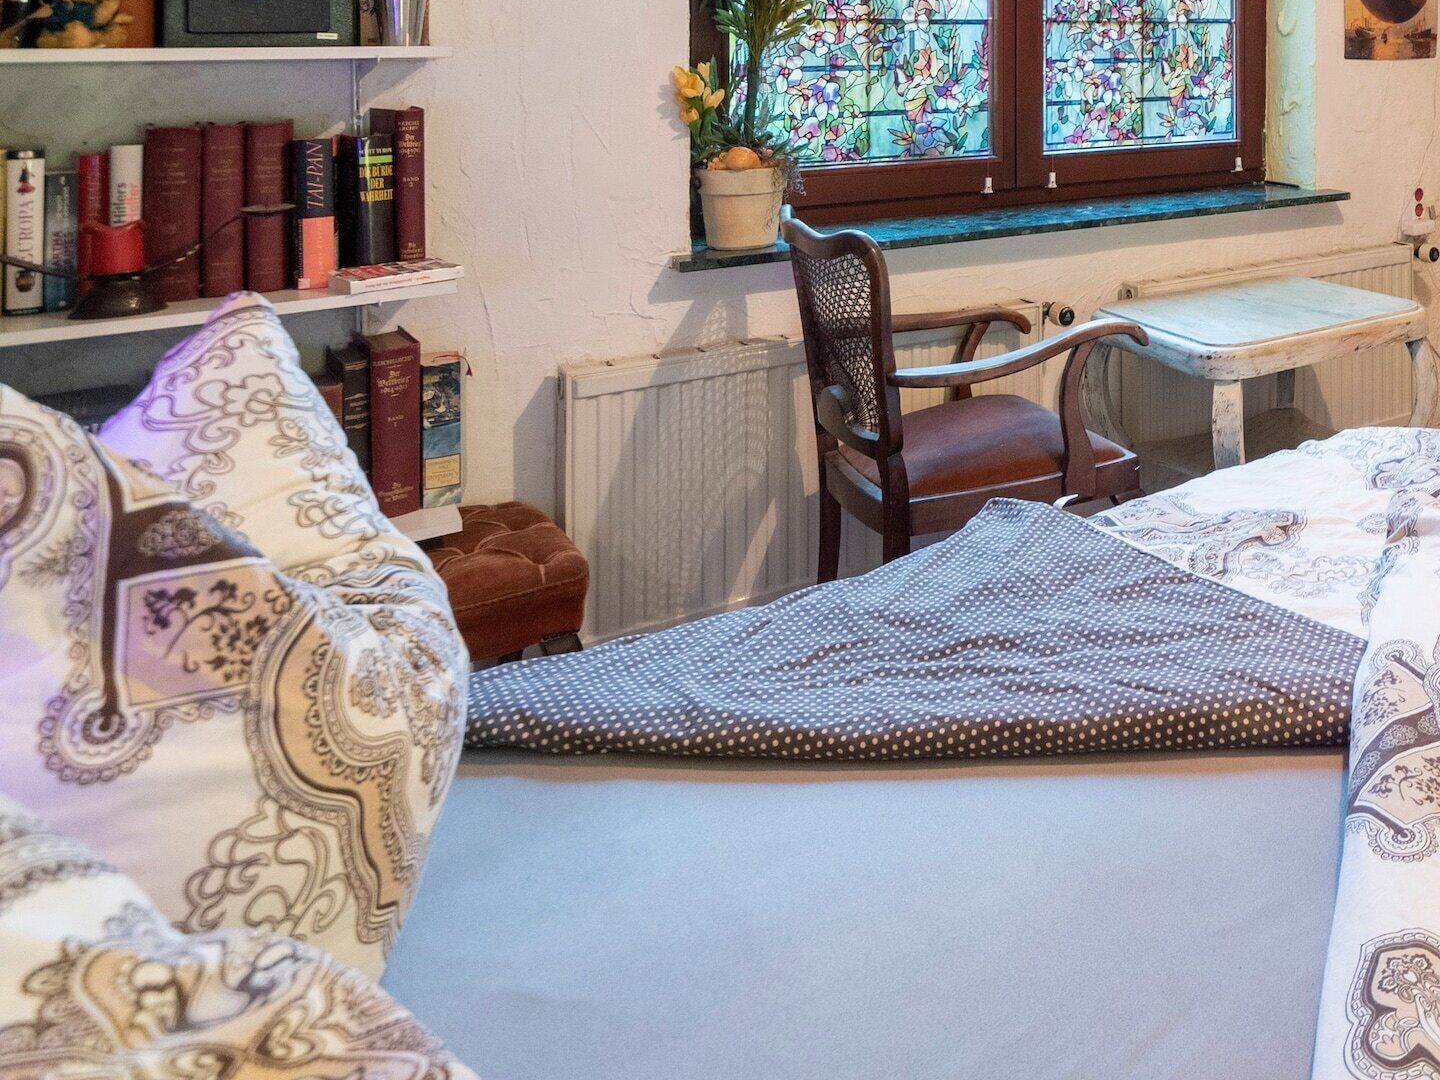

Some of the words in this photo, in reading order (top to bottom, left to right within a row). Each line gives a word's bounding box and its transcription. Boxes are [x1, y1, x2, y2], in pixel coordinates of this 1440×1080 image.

[113, 182, 127, 224] Hitlers
[306, 141, 324, 209] TAI-PAN
[19, 199, 34, 263] EUROPA
